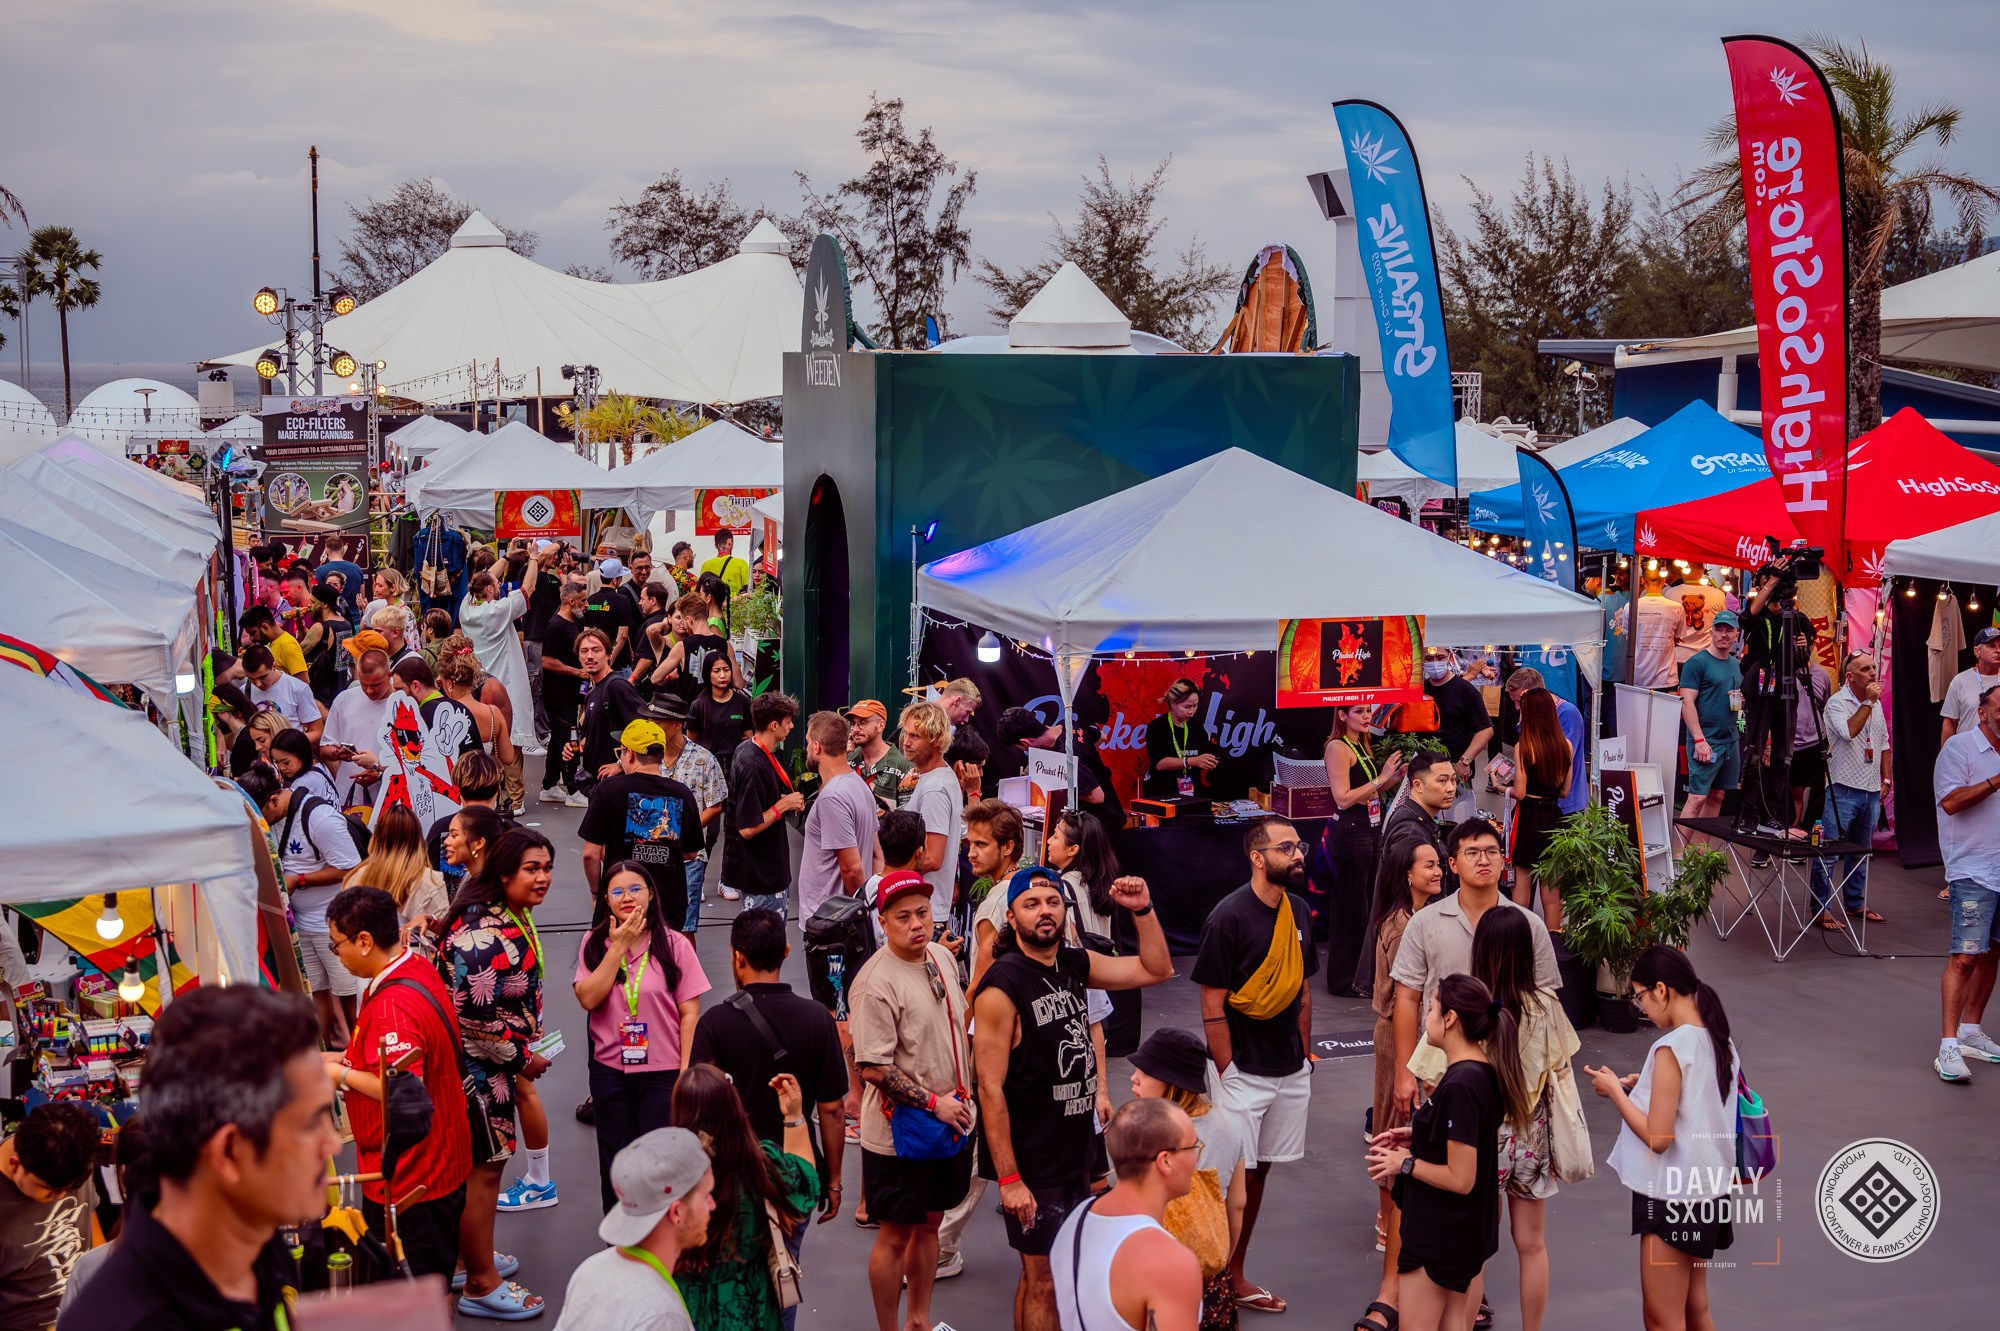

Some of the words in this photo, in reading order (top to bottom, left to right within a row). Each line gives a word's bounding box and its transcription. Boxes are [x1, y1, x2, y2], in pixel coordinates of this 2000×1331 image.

[805, 354, 841, 388] WEEDEN
[286, 417, 346, 430] ECO-FILTERS
[278, 430, 298, 440] MADE
[300, 430, 320, 440] FROM
[320, 430, 354, 440] CANNABIS
[265, 448, 278, 456] YOUR
[278, 446, 310, 456] CONTRIBUTION
[320, 445, 349, 453] SUSTAINABLE
[1810, 615, 1837, 670] RAW
[1332, 649, 1354, 660] Phuket
[1355, 648, 1371, 660] High
[1035, 760, 1057, 777] Phuket
[632, 843, 670, 856] STAR
[632, 852, 669, 864] BUDS
[1052, 1081, 1083, 1101] UNITED
